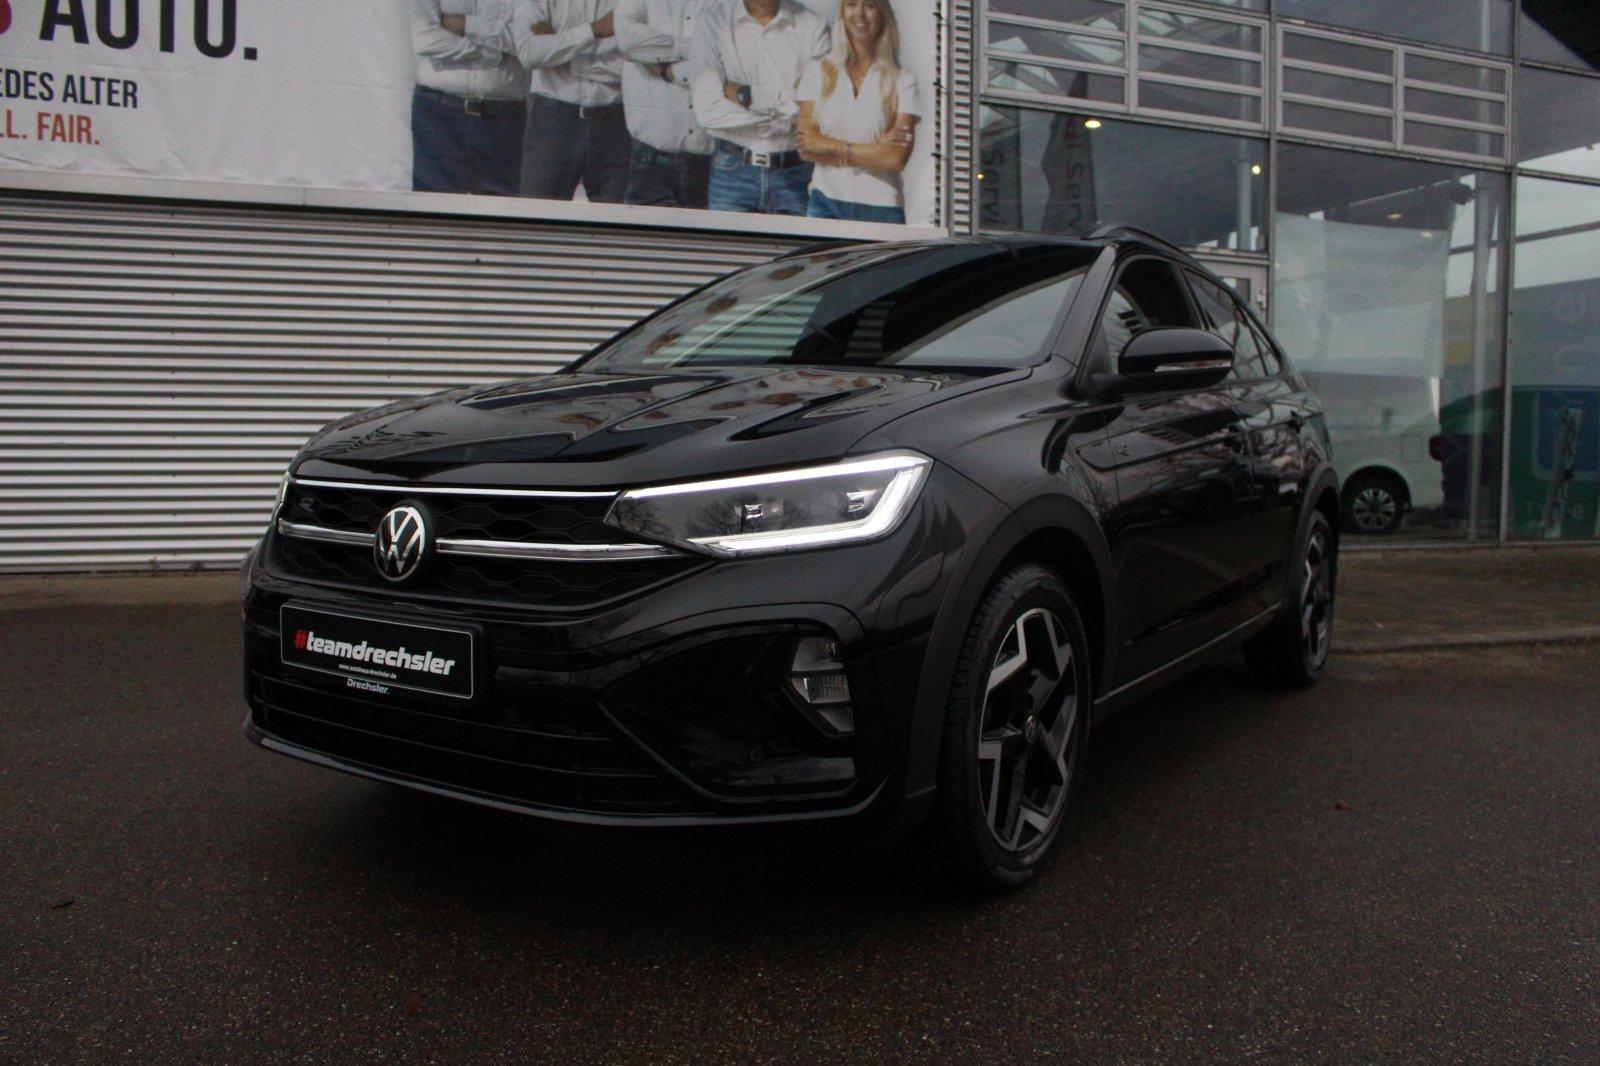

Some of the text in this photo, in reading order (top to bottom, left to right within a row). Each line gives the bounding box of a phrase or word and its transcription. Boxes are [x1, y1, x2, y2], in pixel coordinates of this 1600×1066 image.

[38, 0, 258, 60] AUTO.
[0, 68, 138, 109] DES ALTER
[0, 109, 101, 145] L. FAIR.
[293, 628, 456, 676] #teamdrechsler
